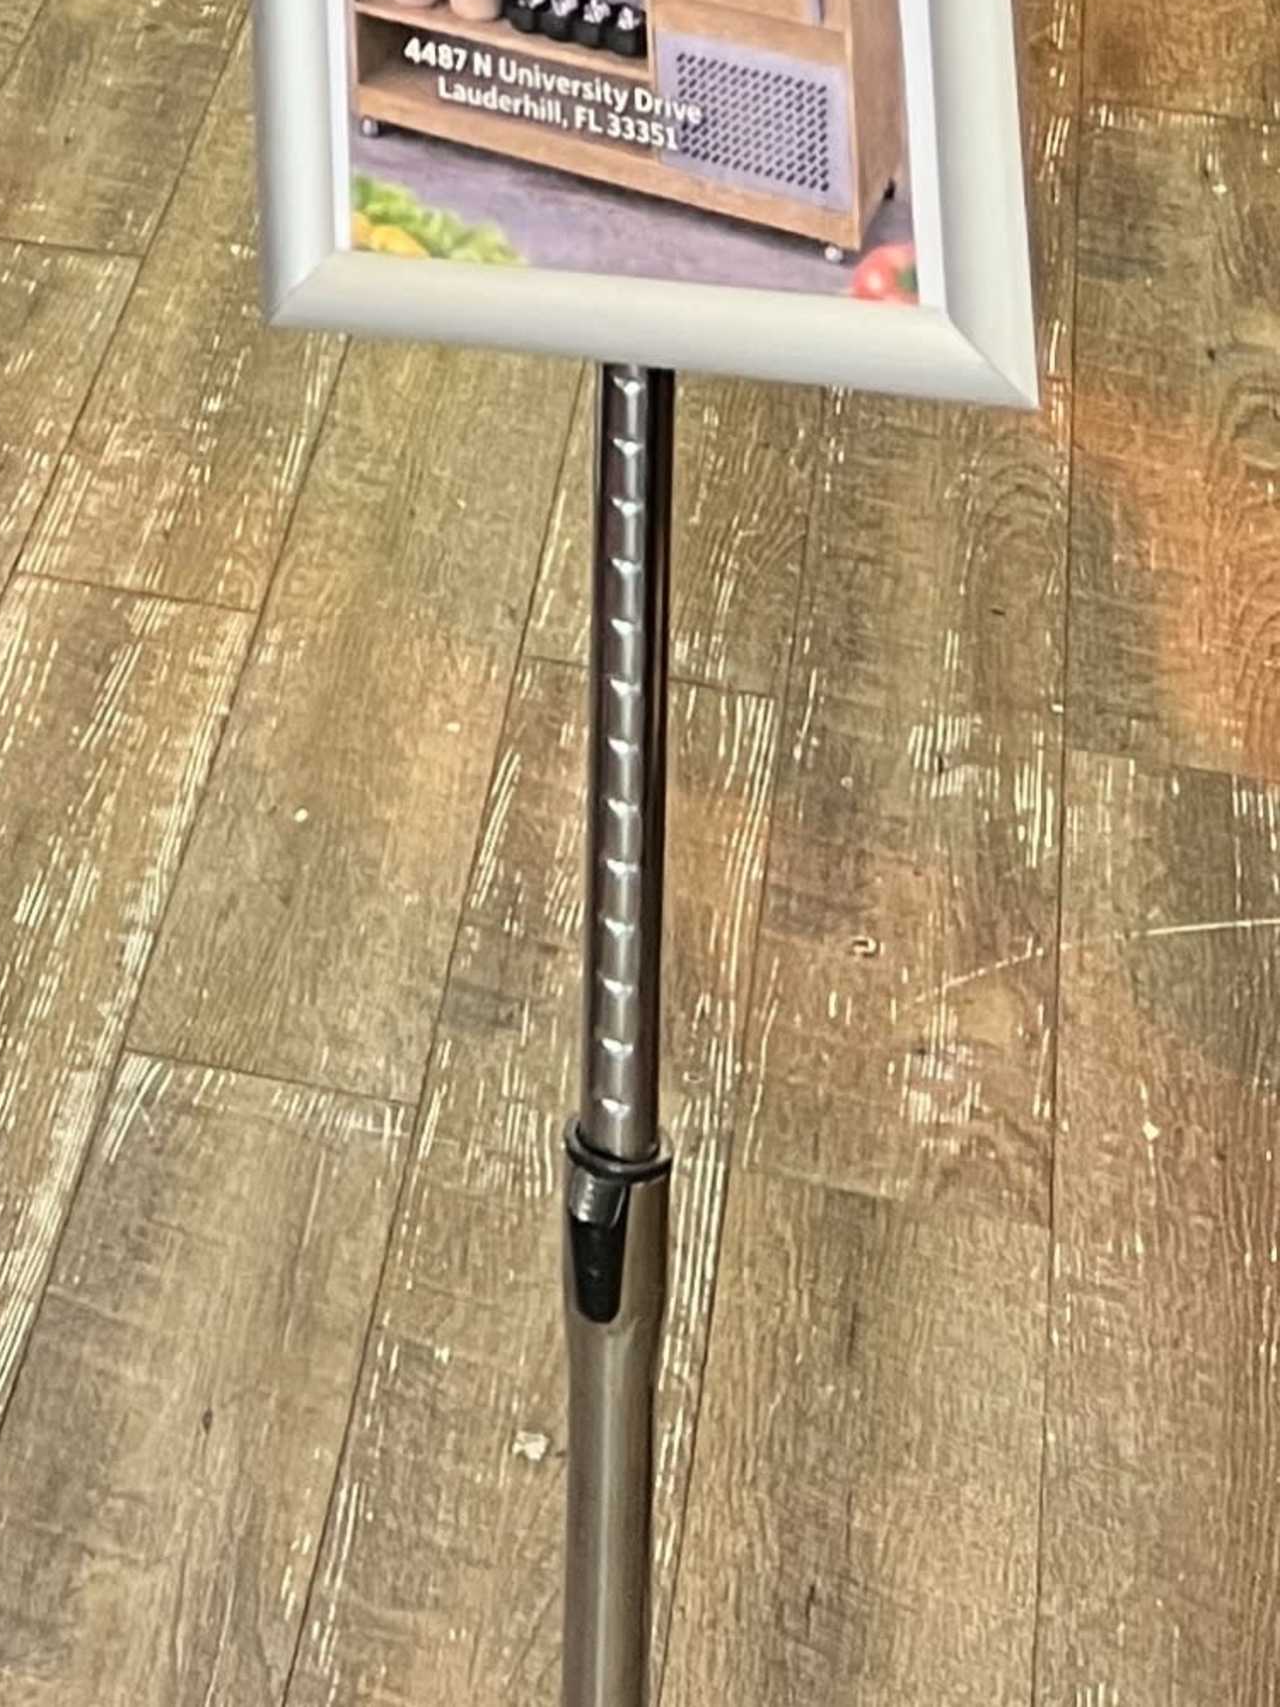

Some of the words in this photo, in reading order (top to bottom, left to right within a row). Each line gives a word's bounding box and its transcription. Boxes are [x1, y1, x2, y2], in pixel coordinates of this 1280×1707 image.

[403, 36, 468, 72] 4487
[473, 53, 492, 78] N
[498, 56, 630, 113] University
[633, 86, 704, 125] Drive
[437, 75, 569, 129] Lauderhill,
[574, 105, 604, 134] FL
[607, 114, 679, 151] 33351
